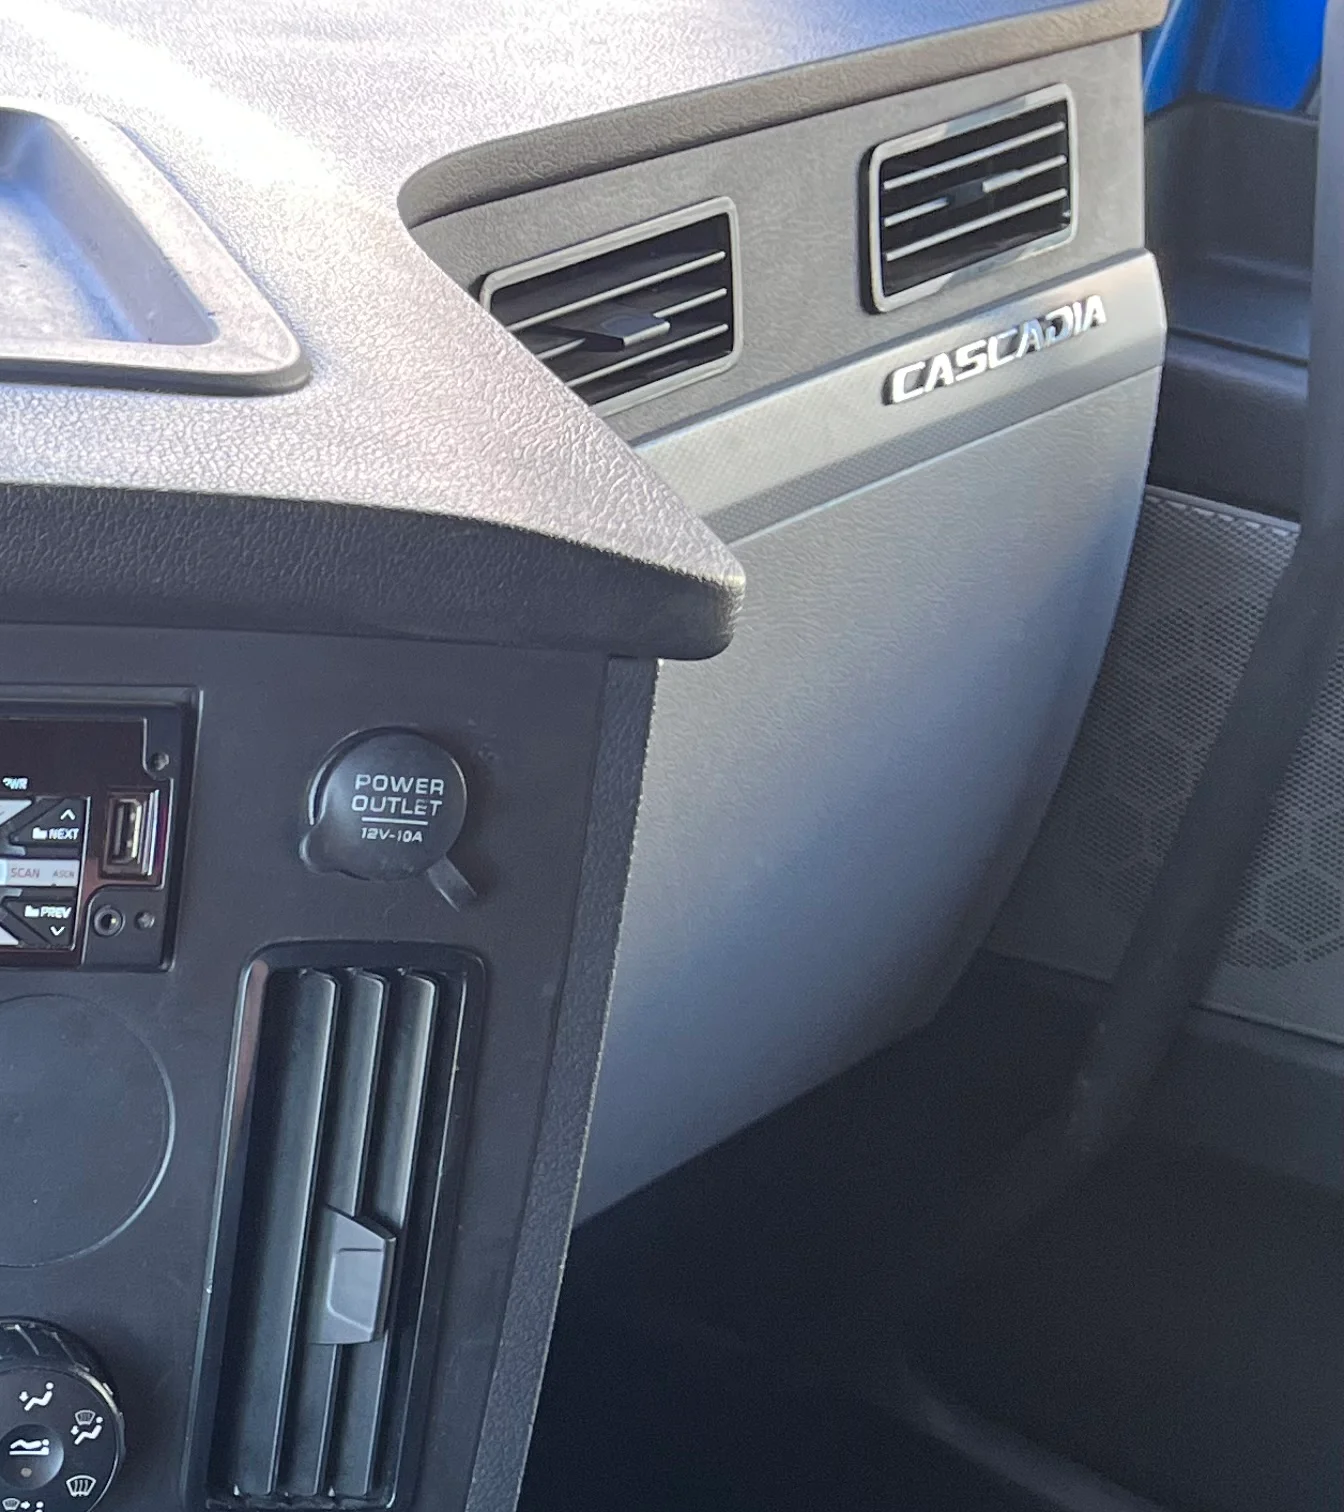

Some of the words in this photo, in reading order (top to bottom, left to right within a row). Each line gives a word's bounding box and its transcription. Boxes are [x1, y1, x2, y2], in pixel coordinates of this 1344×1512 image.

[886, 294, 1107, 406] CASCADIA
[354, 774, 444, 796] POWER
[351, 795, 443, 816] OUTLET
[48, 828, 80, 840] NEXT
[361, 827, 423, 843] 12V-10A
[10, 868, 40, 878] SCAN
[40, 905, 72, 918] PREV
